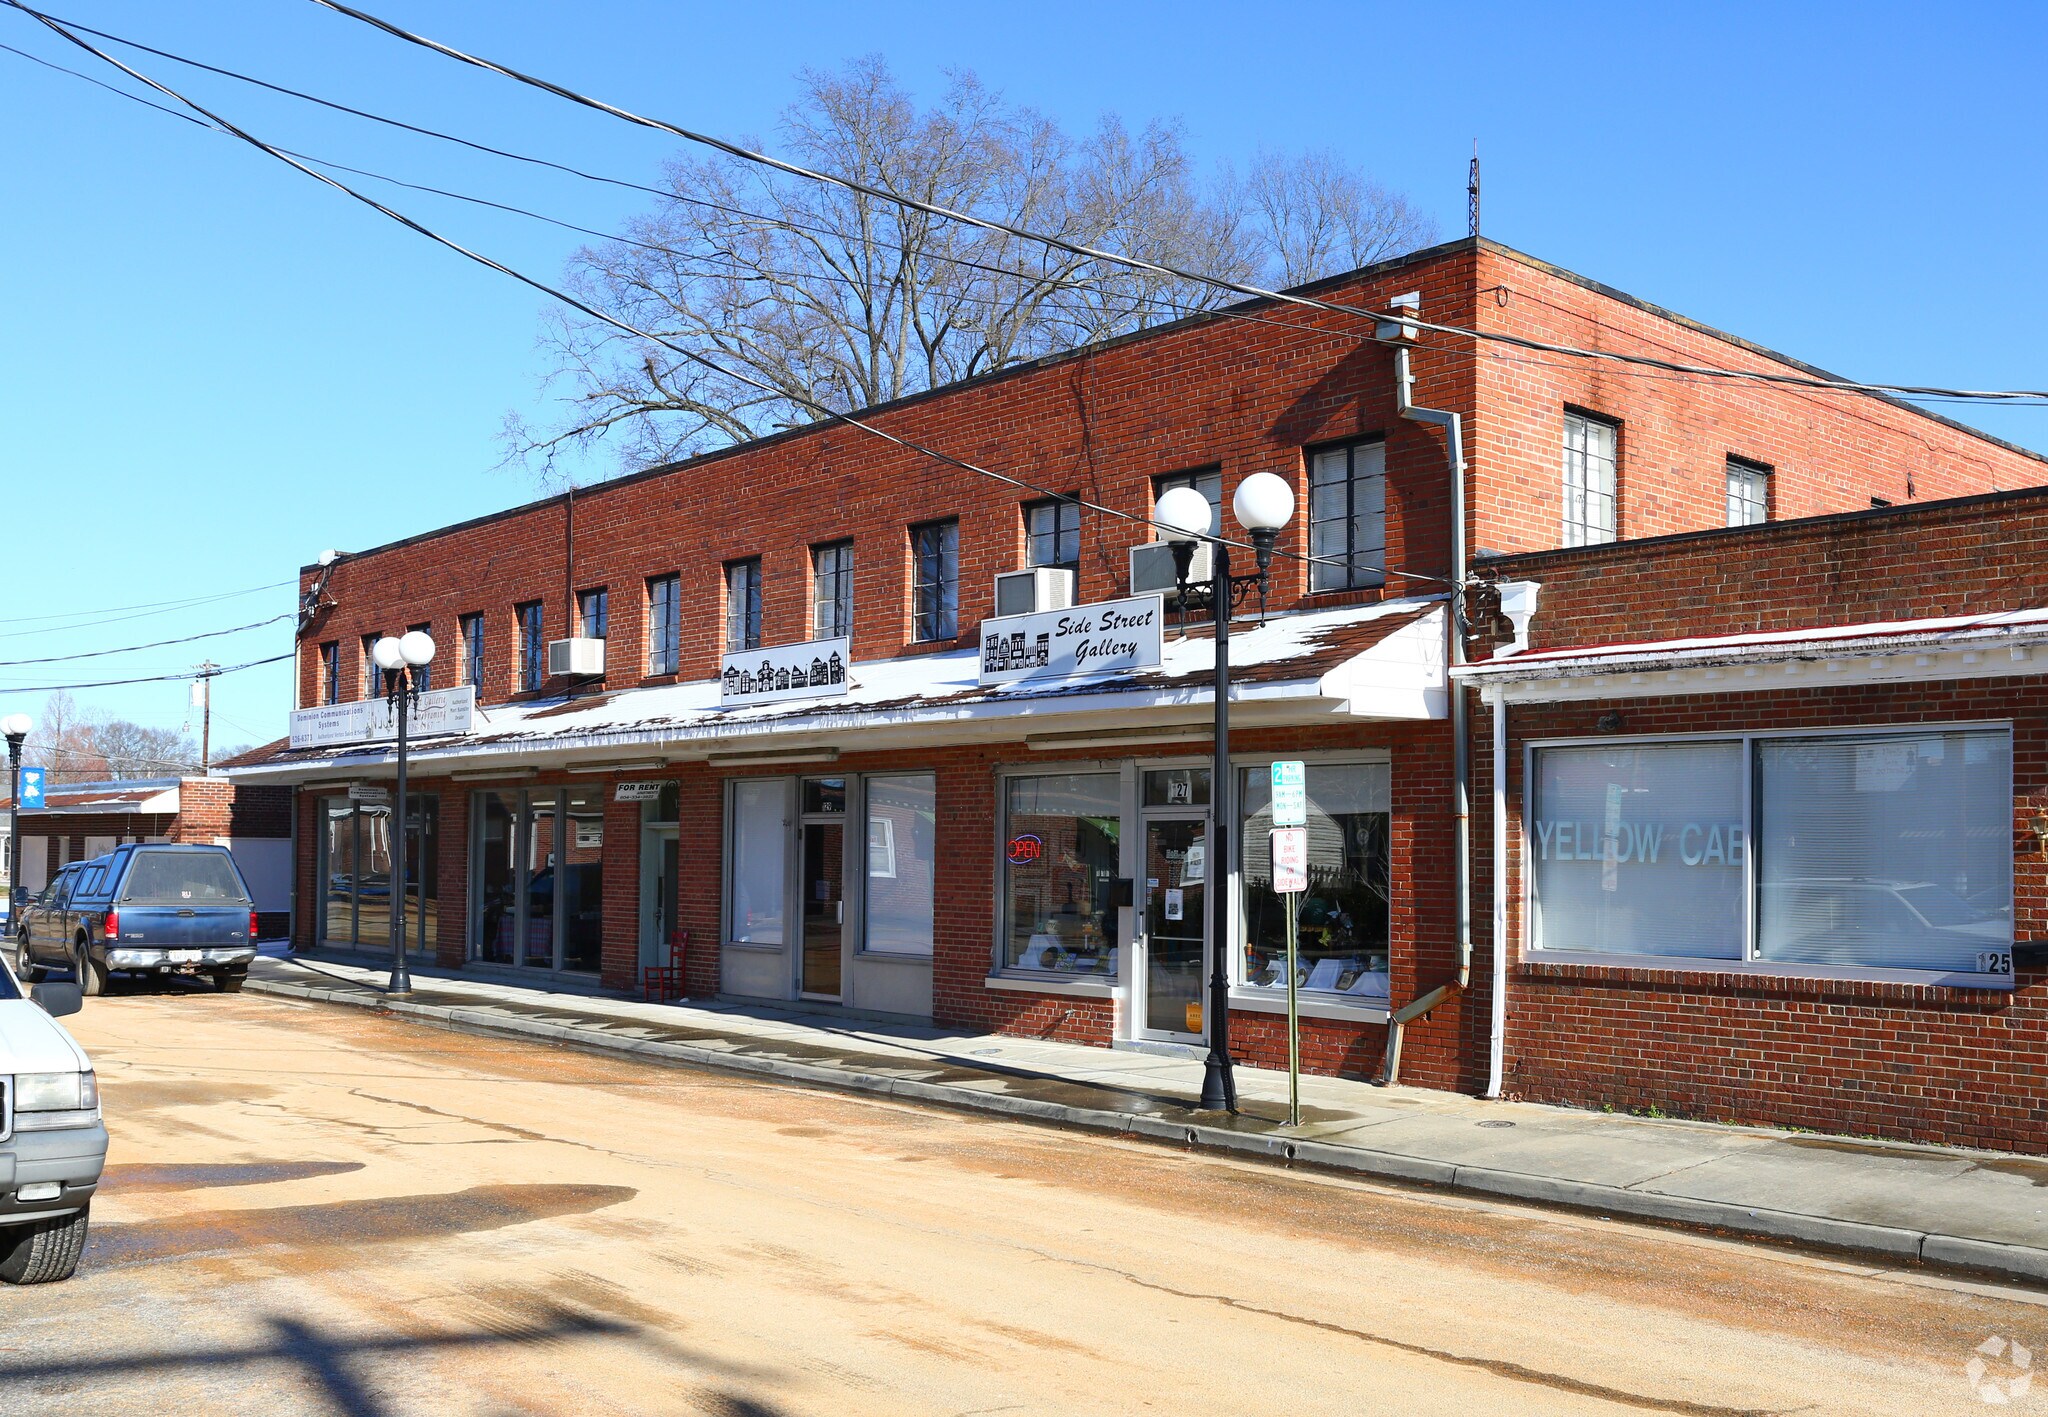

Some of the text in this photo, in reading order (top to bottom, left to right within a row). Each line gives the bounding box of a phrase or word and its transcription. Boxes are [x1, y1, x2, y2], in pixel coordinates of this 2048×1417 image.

[1055, 609, 1154, 637] Side Street
[1075, 638, 1137, 666] Gallery
[297, 707, 364, 722] Dominion Communications
[318, 720, 339, 730] Systems
[1274, 766, 1282, 782] 2
[1283, 774, 1301, 783] PARKING
[638, 783, 660, 791] RENT
[1285, 833, 1294, 842] NO
[1283, 844, 1296, 853] BIKE
[1535, 820, 1744, 867] YELLOW CAB
[1007, 840, 1041, 858] OPEN
[1280, 855, 1299, 864] RIDING
[1286, 866, 1295, 875] ON
[1276, 877, 1305, 887] SIDEWALK
